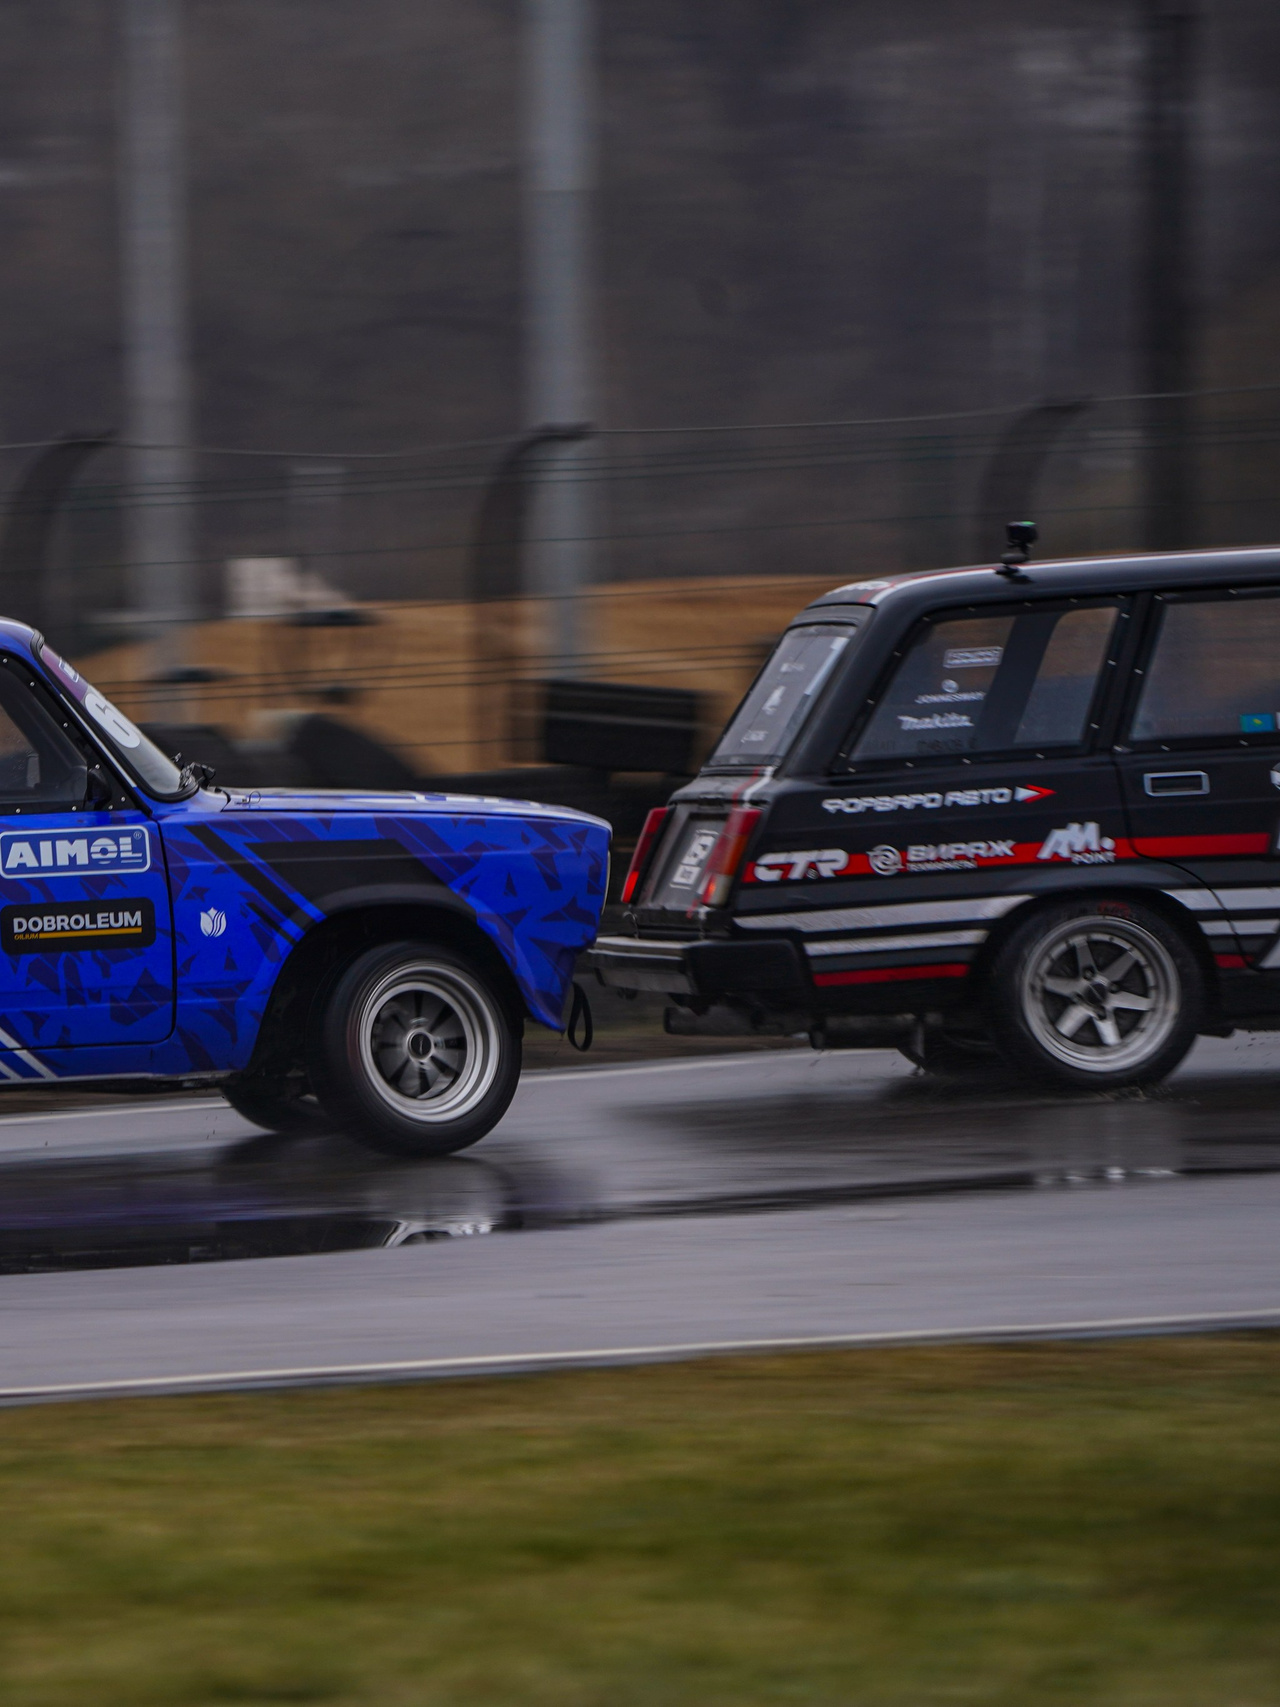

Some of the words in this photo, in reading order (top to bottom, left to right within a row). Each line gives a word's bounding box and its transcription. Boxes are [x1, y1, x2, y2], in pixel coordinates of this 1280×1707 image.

[945, 787, 1012, 807] АВТО
[5, 837, 143, 869] AIMOL
[754, 848, 849, 882] CTR
[12, 910, 142, 934] DOBROLEUM
